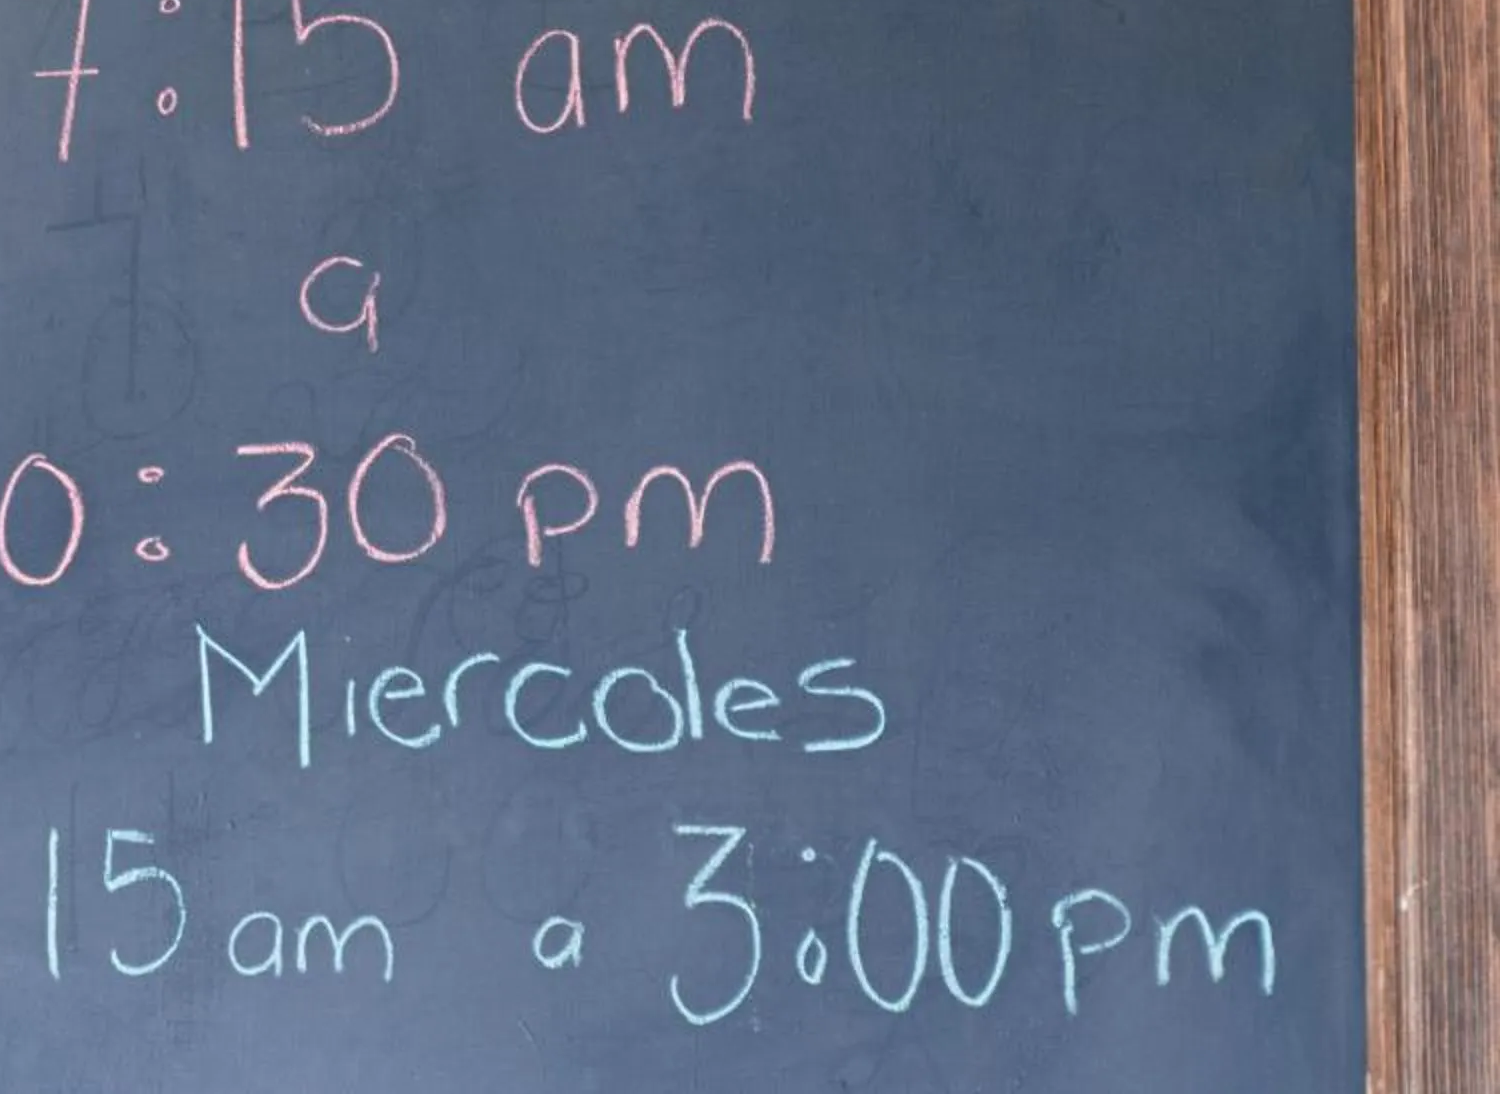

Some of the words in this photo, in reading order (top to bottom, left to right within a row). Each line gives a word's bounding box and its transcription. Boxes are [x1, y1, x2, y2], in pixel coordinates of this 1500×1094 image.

[515, 17, 756, 134] am
[300, 256, 381, 352] a
[520, 461, 776, 567] pm
[196, 623, 886, 769] Miercoles
[228, 910, 394, 982] am
[532, 915, 585, 970] a
[669, 824, 1013, 1025] 3:00
[1052, 888, 1276, 1015] pm
